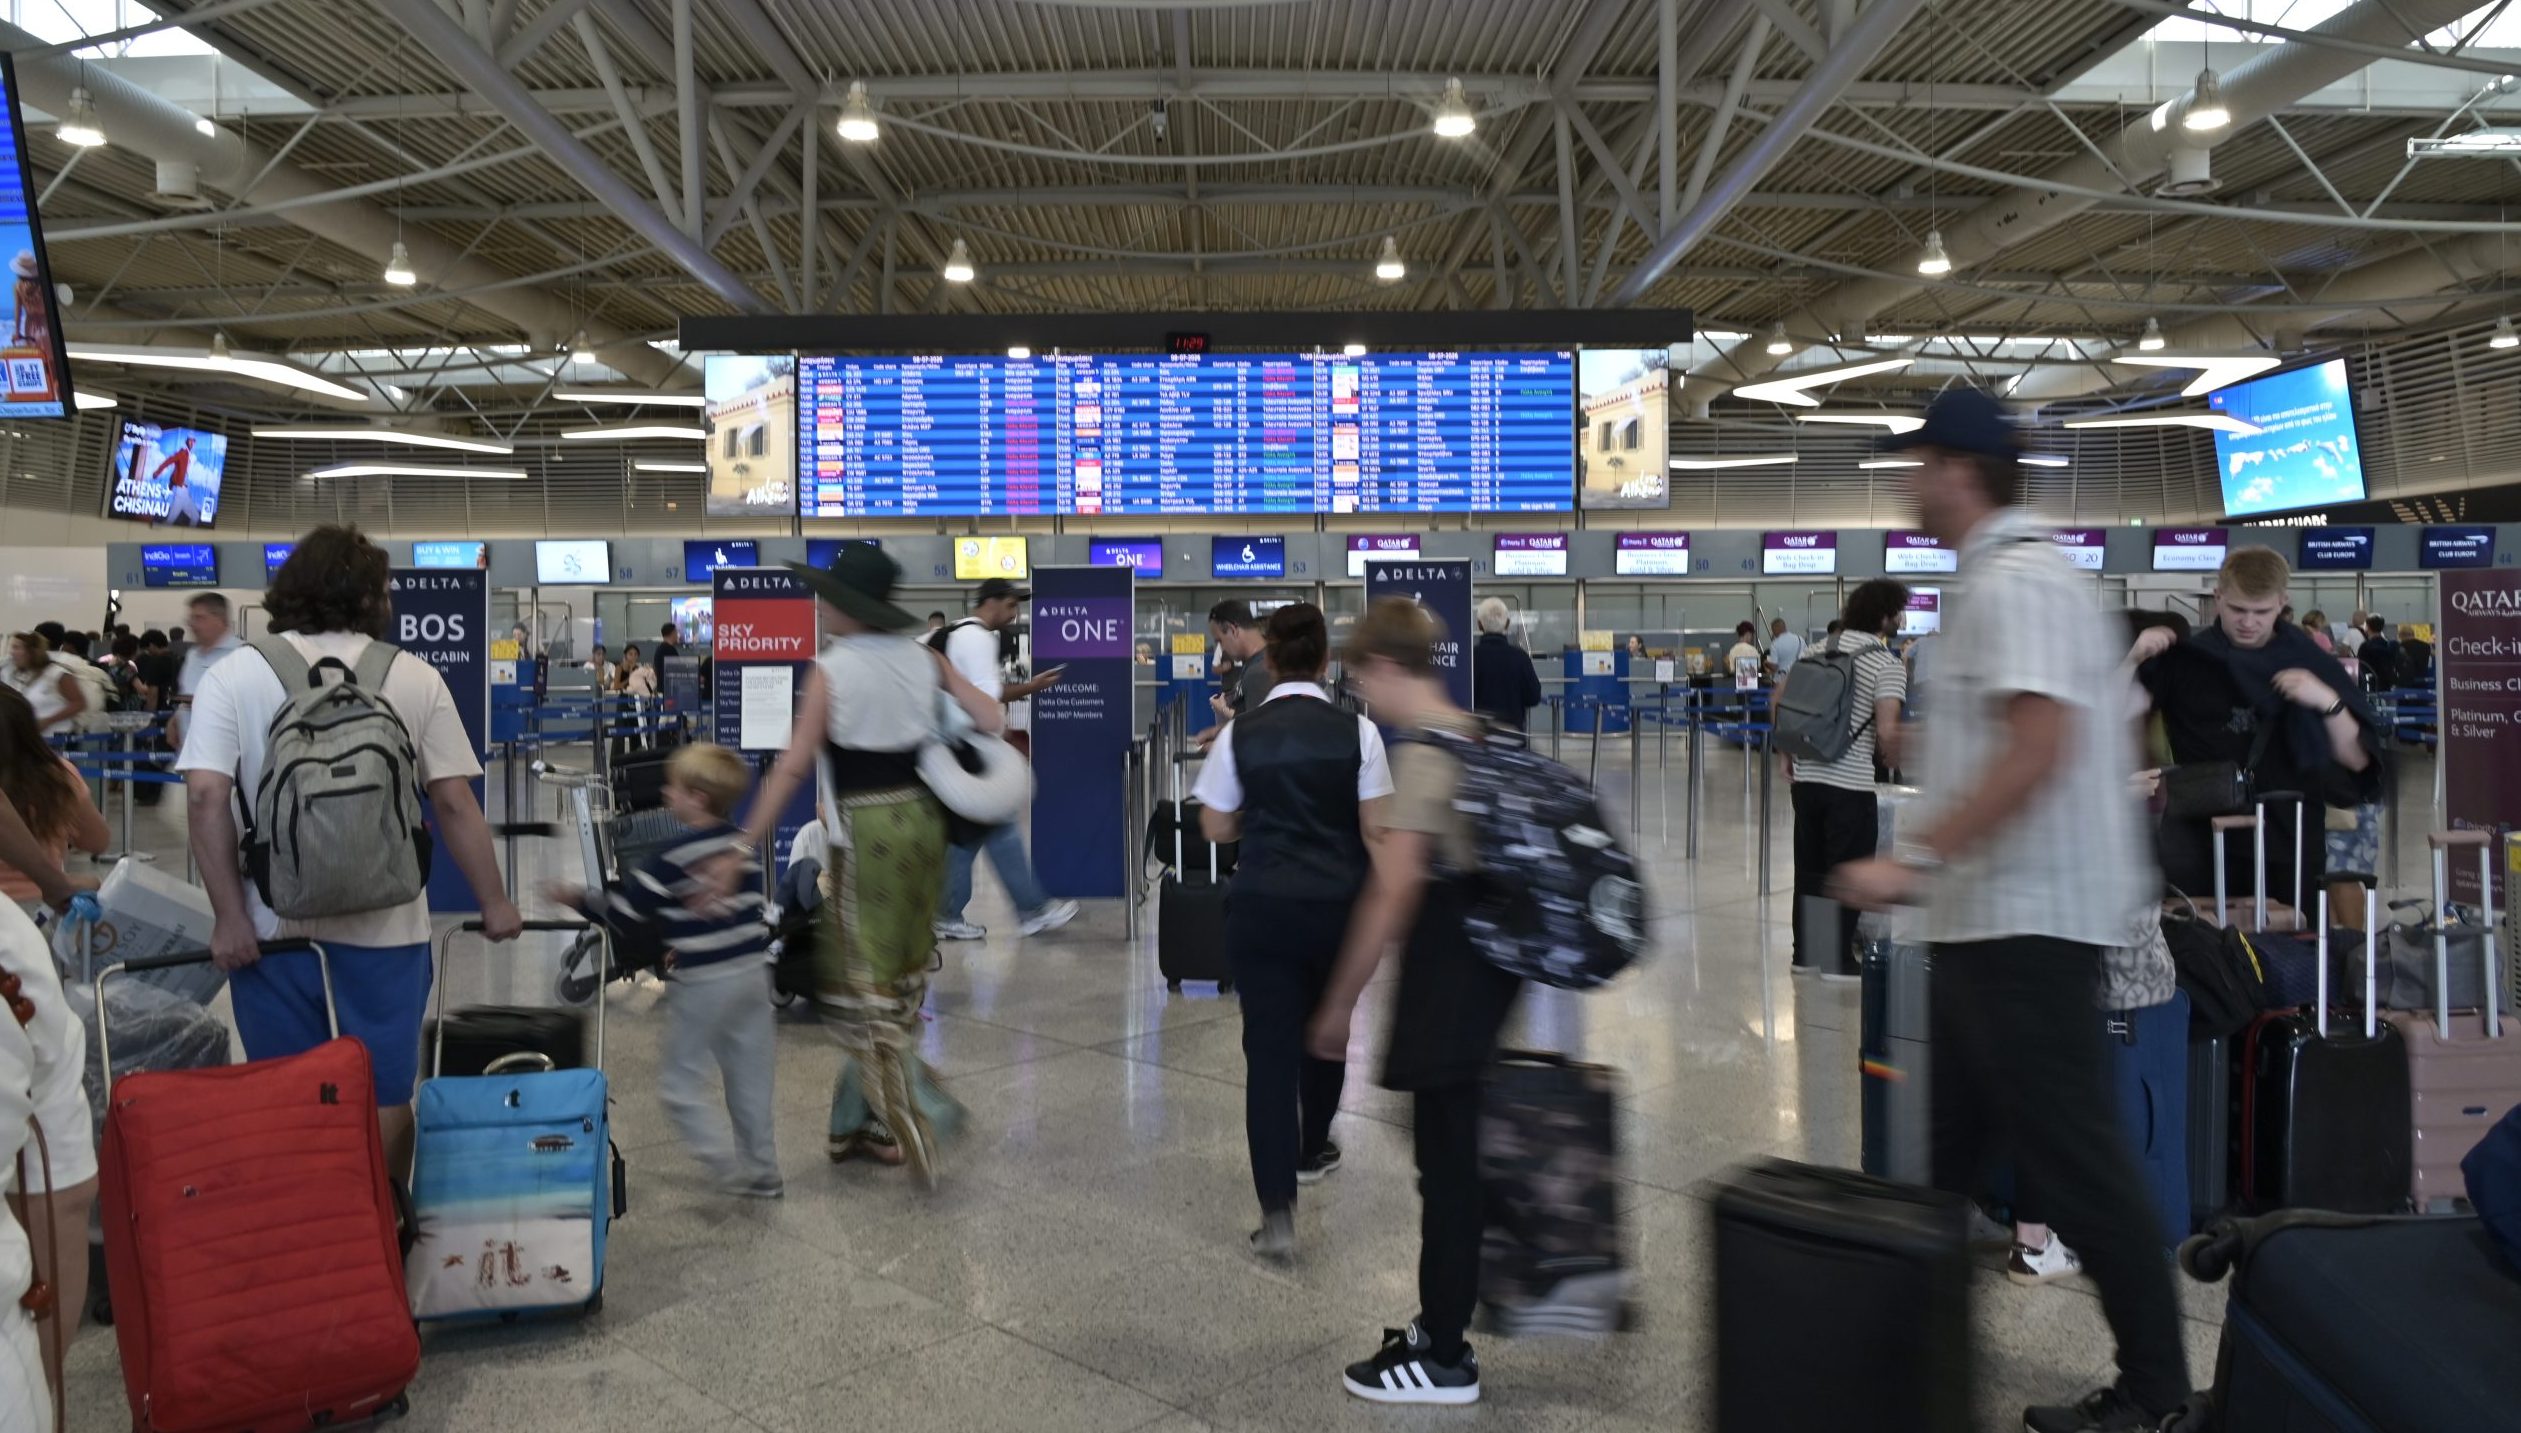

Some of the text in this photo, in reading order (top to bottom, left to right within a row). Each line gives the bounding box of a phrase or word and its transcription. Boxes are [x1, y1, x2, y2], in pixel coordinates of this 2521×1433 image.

[1175, 336, 1205, 350] 11:29
[116, 478, 162, 498] ATHENS
[114, 495, 170, 518] CHISINAU
[1783, 537, 1807, 546] QATAR
[1906, 536, 1930, 545] QATAR
[2174, 533, 2198, 543] QATAR
[416, 546, 433, 555] BUY
[442, 546, 460, 554] WIN
[2317, 551, 2356, 559] CLUB EUROPE
[1116, 554, 1143, 566] ONE
[1741, 558, 1754, 570] 49
[2085, 553, 2098, 563] 20
[2163, 554, 2217, 563] Economy Class
[1393, 567, 1447, 581] DELTA
[406, 577, 461, 590] DELTA
[740, 576, 792, 590] DELTA
[1051, 606, 1088, 616] DELTA
[400, 613, 465, 643] BOS
[718, 623, 754, 637] SKY
[1061, 619, 1118, 642] ONE
[718, 636, 802, 652] PRIORITY
[431, 650, 470, 664] CABIN
[1054, 684, 1099, 693] WELCOME:
[2450, 677, 2502, 691] Business
[1038, 698, 1104, 706] Delta One Customers
[1038, 710, 1055, 719] Delta
[1073, 710, 1103, 720] Members
[2451, 708, 2509, 725] Platinum,
[2451, 724, 2496, 739] & Silver
